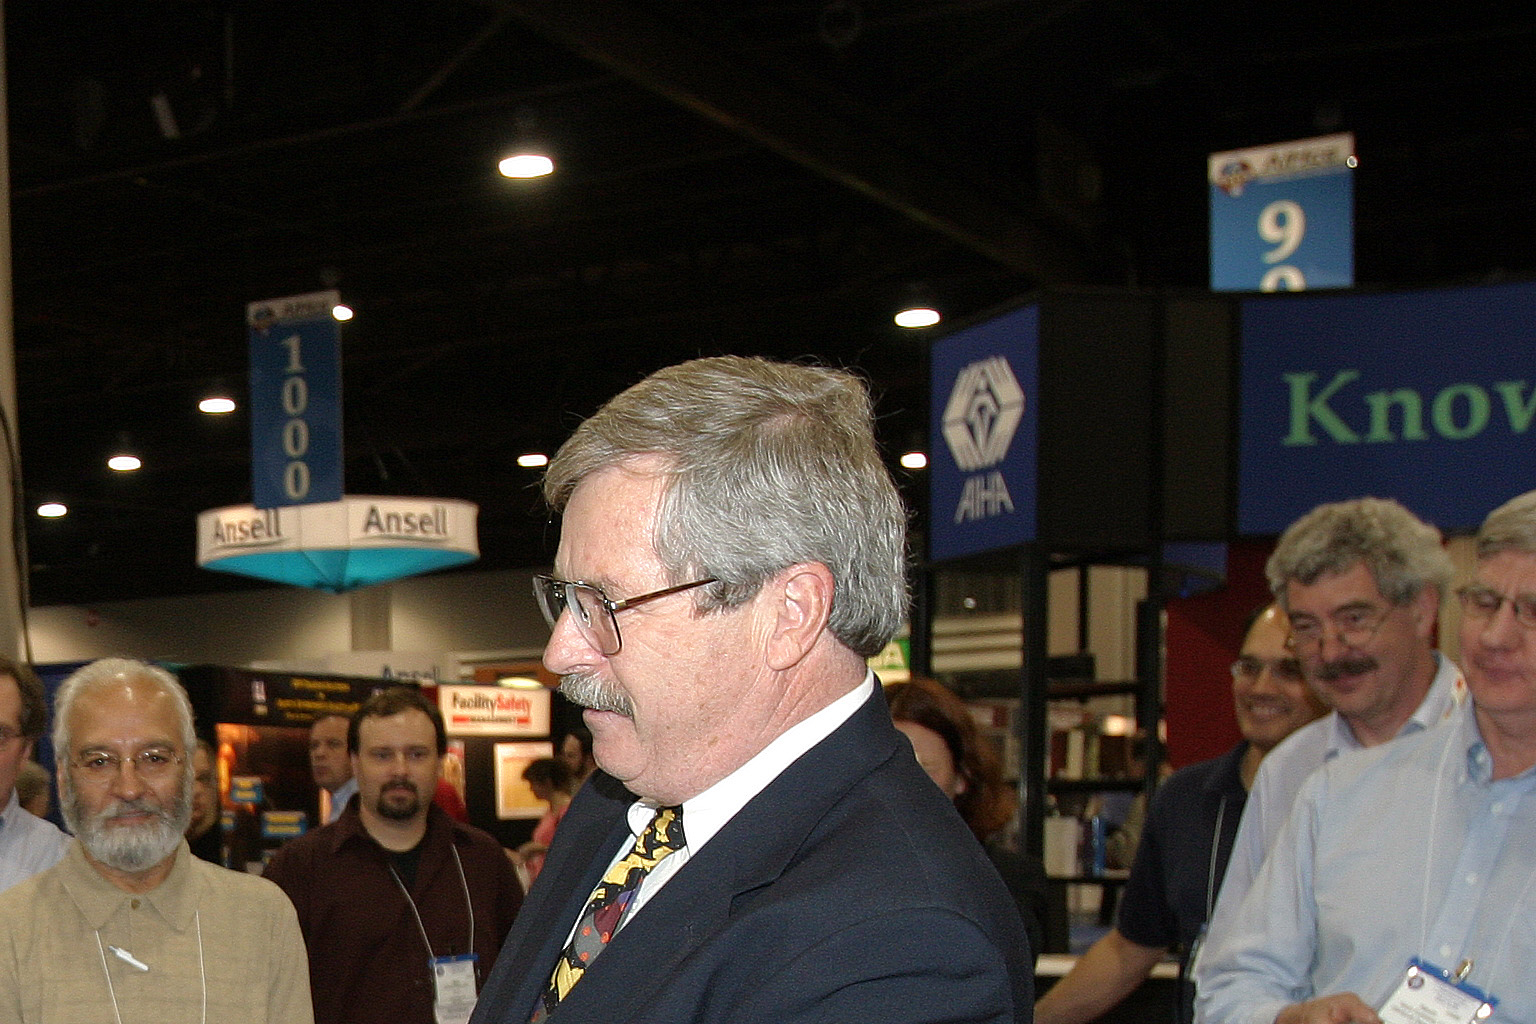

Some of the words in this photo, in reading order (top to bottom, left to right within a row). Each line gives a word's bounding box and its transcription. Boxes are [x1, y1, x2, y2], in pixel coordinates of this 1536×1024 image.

[280, 335, 310, 500] 1000
[953, 471, 1014, 524] AIHA
[215, 508, 281, 543] Ansell
[364, 504, 448, 536] Ansell
